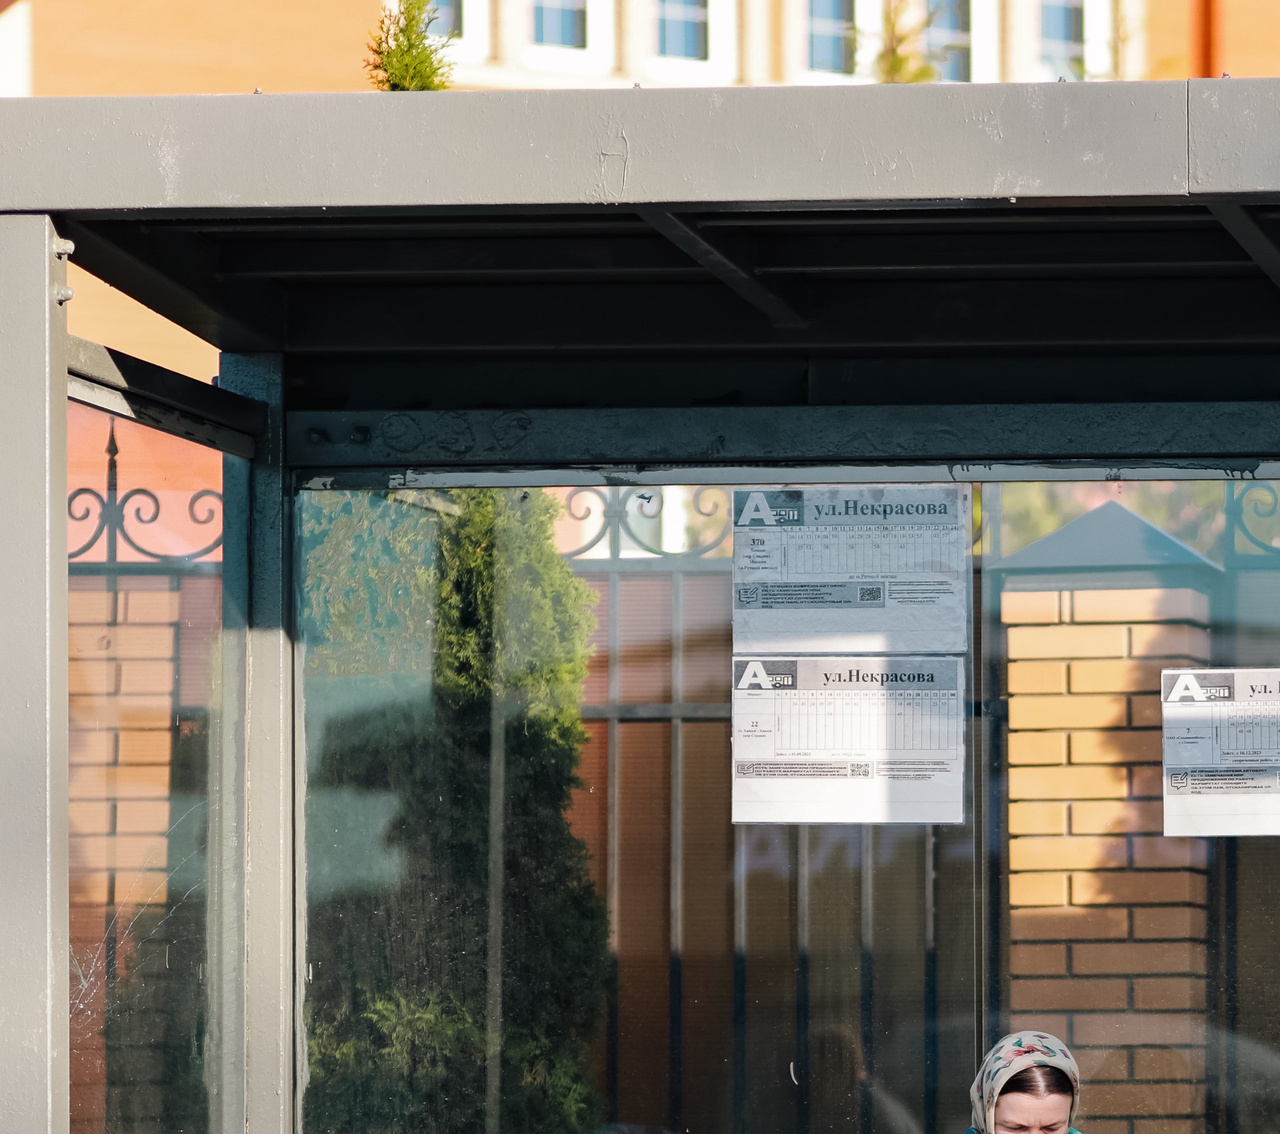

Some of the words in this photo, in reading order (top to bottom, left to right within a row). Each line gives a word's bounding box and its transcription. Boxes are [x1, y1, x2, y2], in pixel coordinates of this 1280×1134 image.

[814, 499, 948, 520] ул.Некрасова
[823, 669, 935, 688] ул.Некрасова
[1249, 683, 1272, 698] ул.
